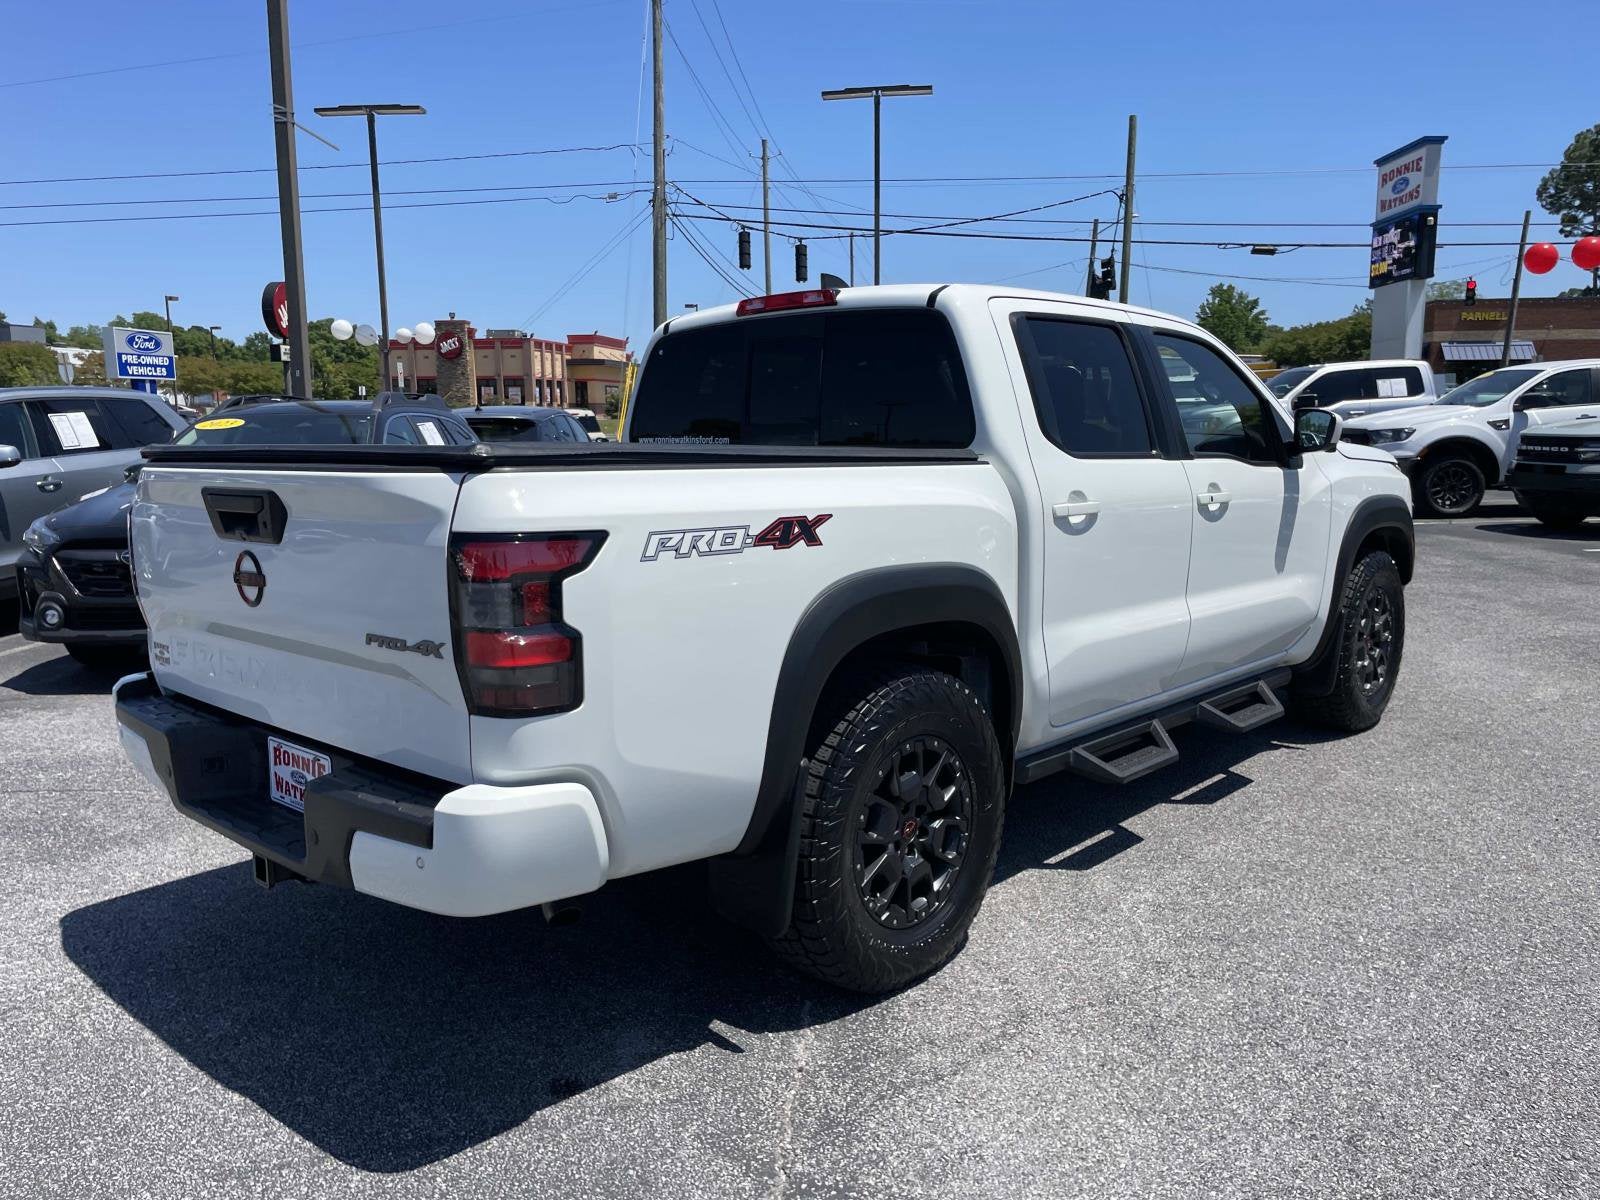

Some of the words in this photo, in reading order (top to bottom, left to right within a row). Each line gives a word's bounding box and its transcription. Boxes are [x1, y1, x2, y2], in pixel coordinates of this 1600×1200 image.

[1381, 156, 1423, 188] RONNIE
[1380, 184, 1421, 212] WATKINS
[1461, 311, 1508, 320] PARNELL
[132, 335, 156, 349] Ford
[121, 354, 170, 366] PRE-OWNED
[126, 366, 168, 376] VEHICLES
[273, 744, 326, 778] RONNIE
[274, 771, 305, 802] WATK
